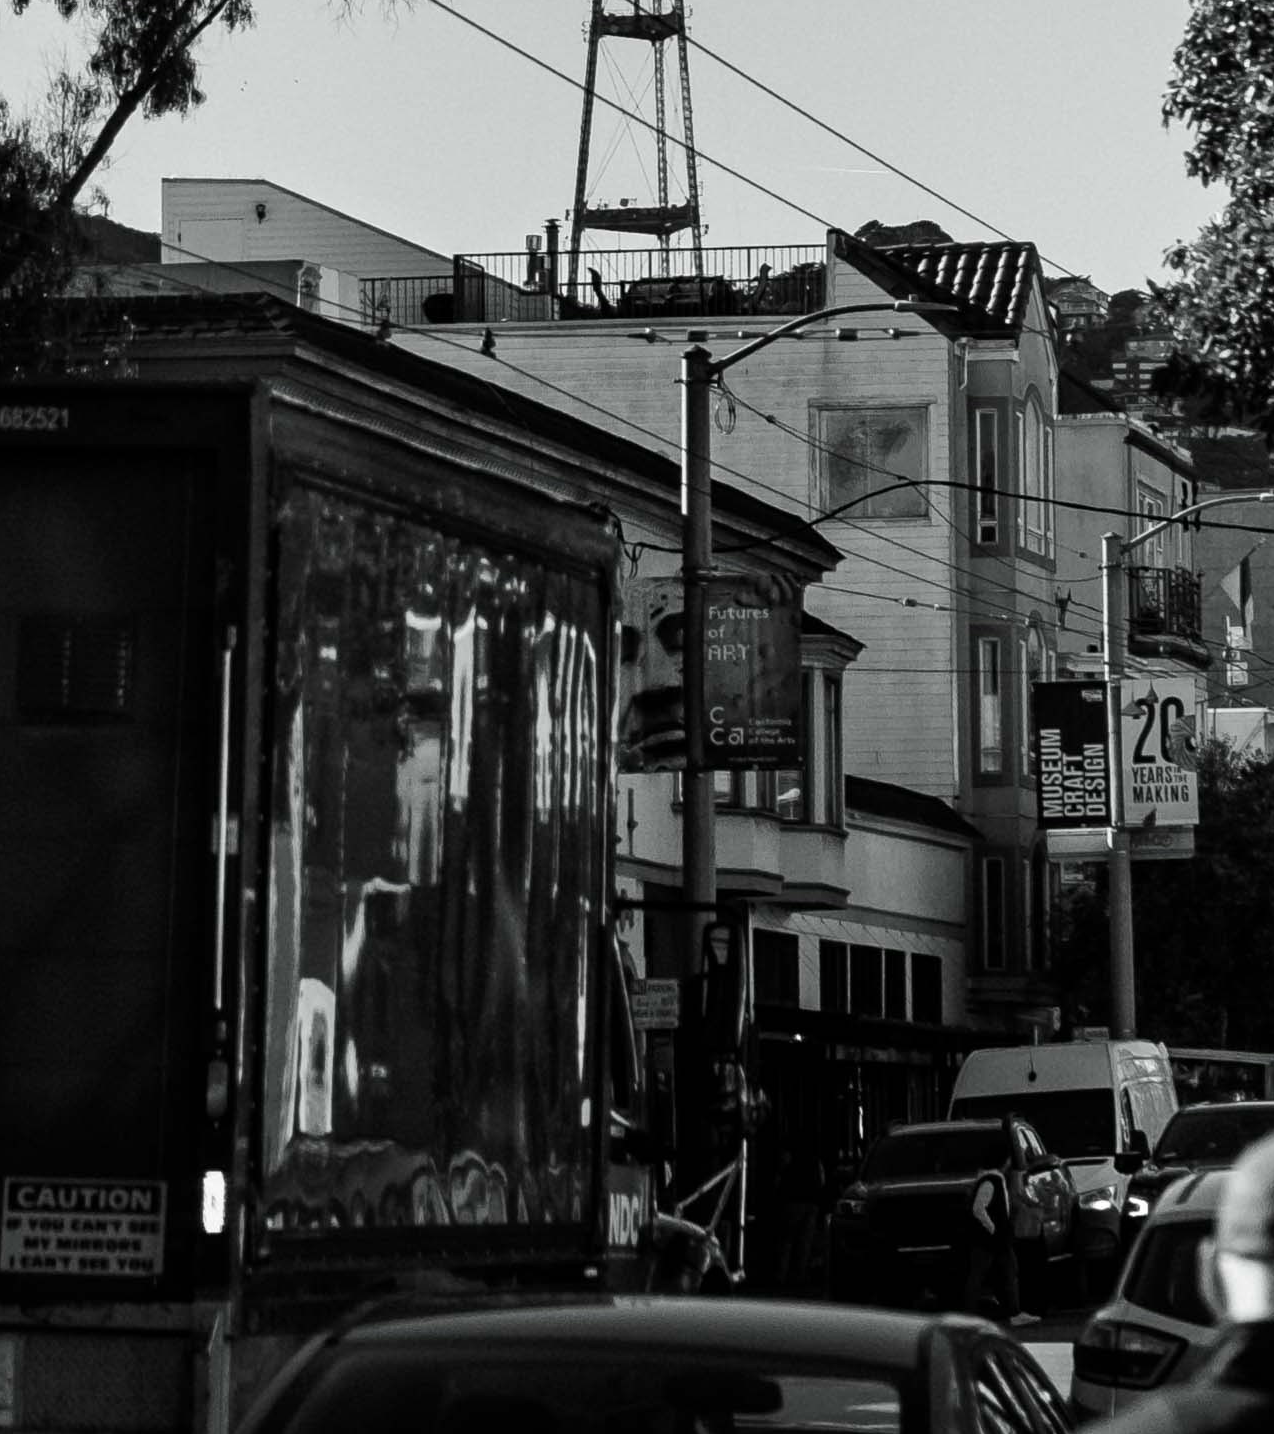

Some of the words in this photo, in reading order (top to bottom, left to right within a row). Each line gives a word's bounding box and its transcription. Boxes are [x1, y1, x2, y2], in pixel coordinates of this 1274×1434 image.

[708, 606, 769, 620] Futures
[708, 625, 725, 638] of
[708, 644, 750, 661] ART
[1040, 729, 1063, 818] MUSEUM
[1083, 744, 1106, 817] DESIGN
[1132, 766, 1172, 784] YEARS
[1063, 752, 1085, 817] CRAFT
[1133, 785, 1189, 804] MAKING
[16, 1185, 153, 1212] CAUTION
[29, 1218, 64, 1231] YOU
[25, 1236, 50, 1250] MY
[57, 1238, 142, 1252] MIRRORS
[117, 1257, 154, 1272] YOU
